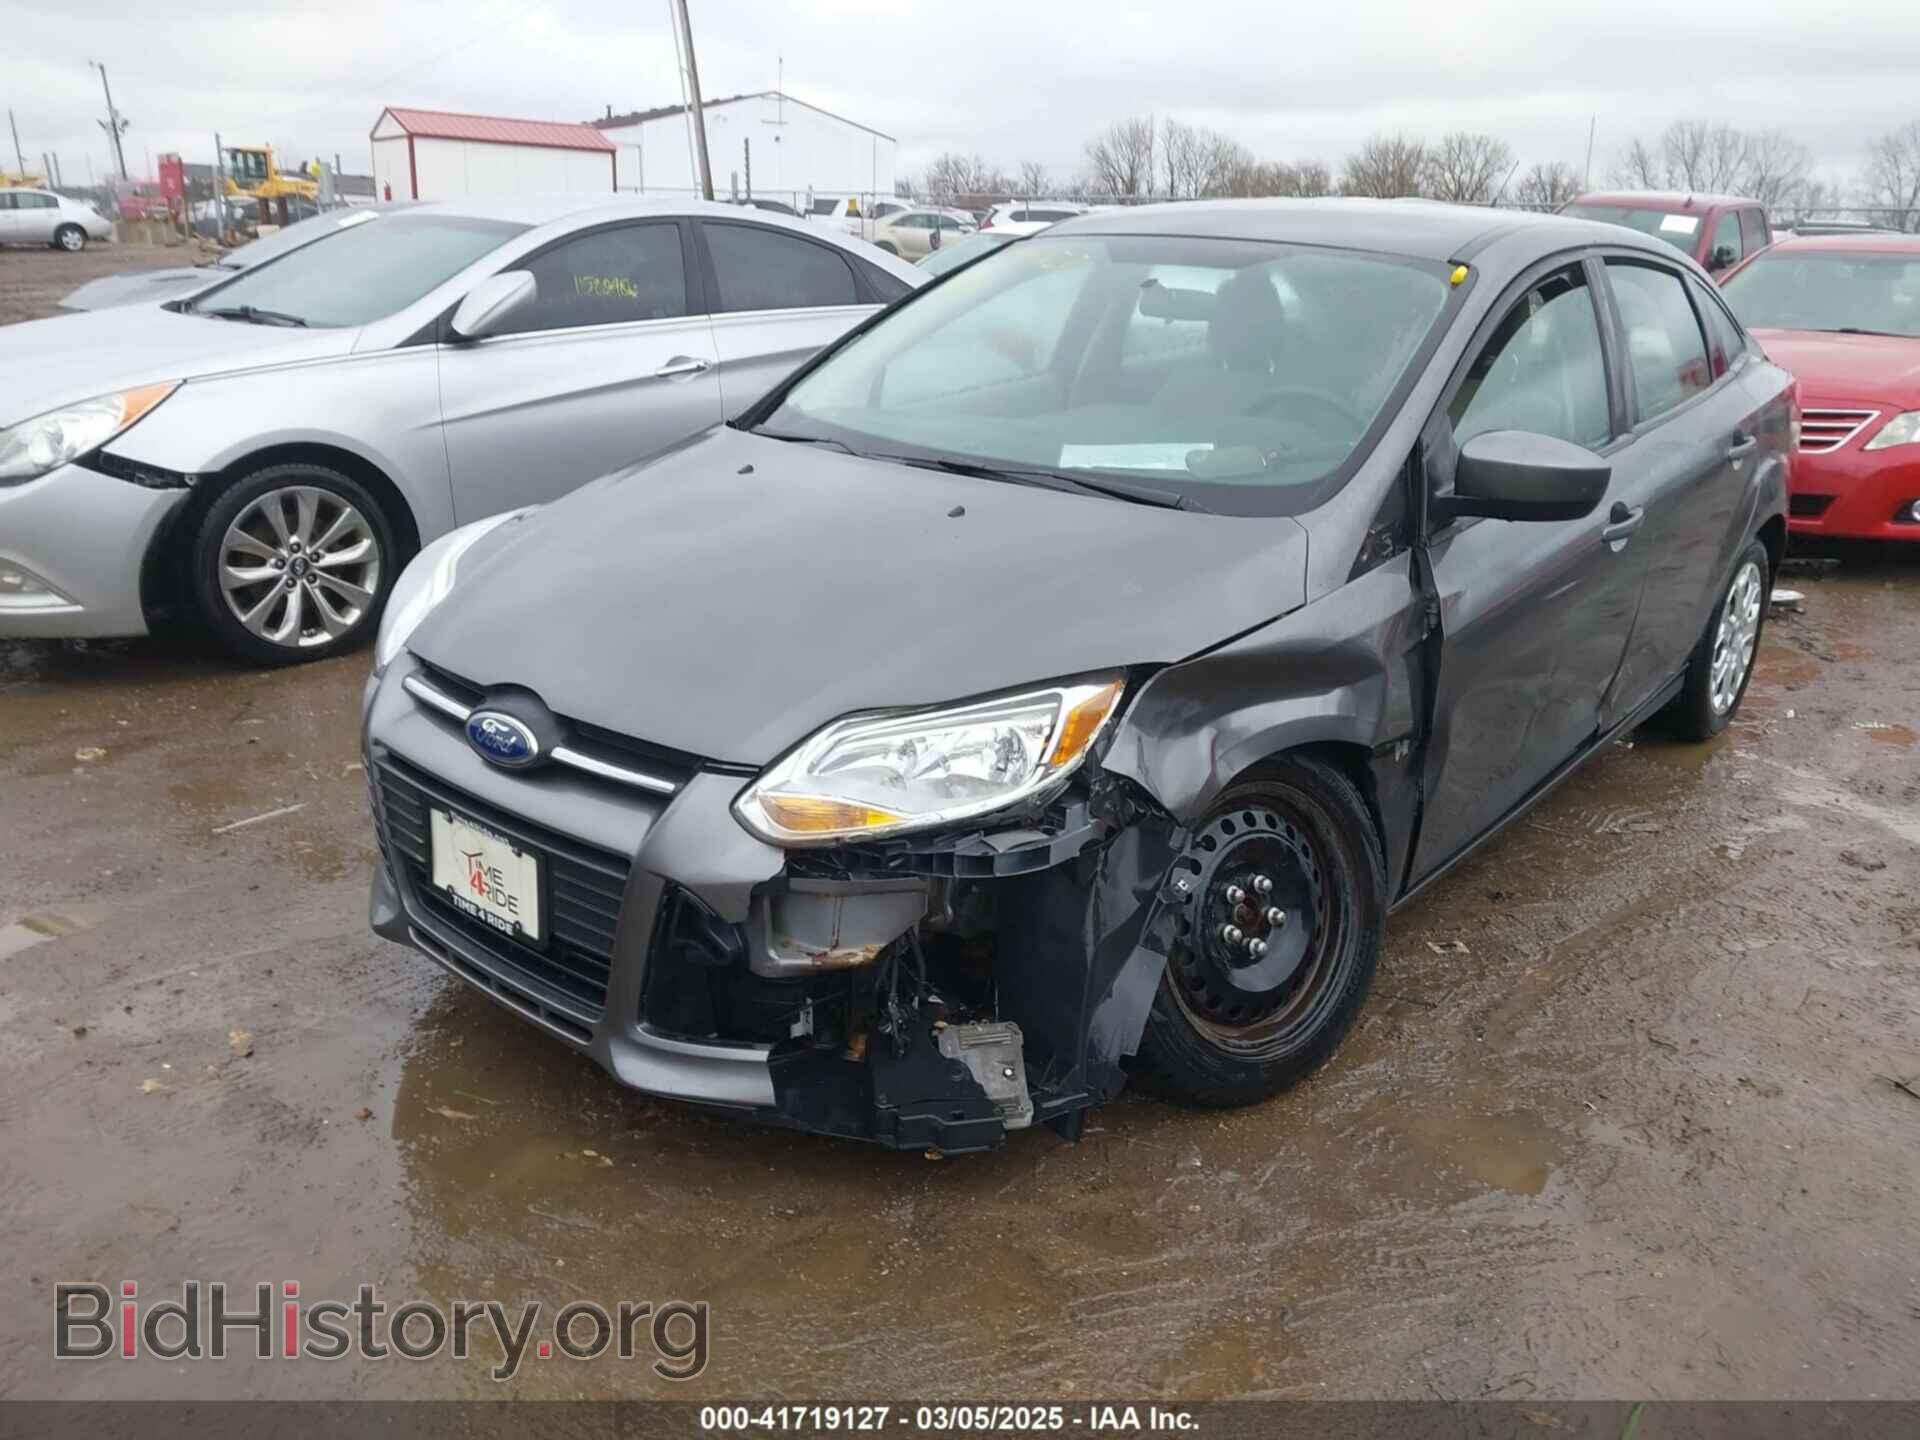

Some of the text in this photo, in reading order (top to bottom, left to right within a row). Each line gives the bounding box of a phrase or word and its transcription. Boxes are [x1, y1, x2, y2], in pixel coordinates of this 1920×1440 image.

[476, 718, 518, 753] Ford
[459, 848, 504, 888] TIME
[470, 868, 486, 897] 4
[452, 894, 478, 918] TIME
[486, 913, 514, 937] RIDE
[483, 880, 519, 916] RIDE
